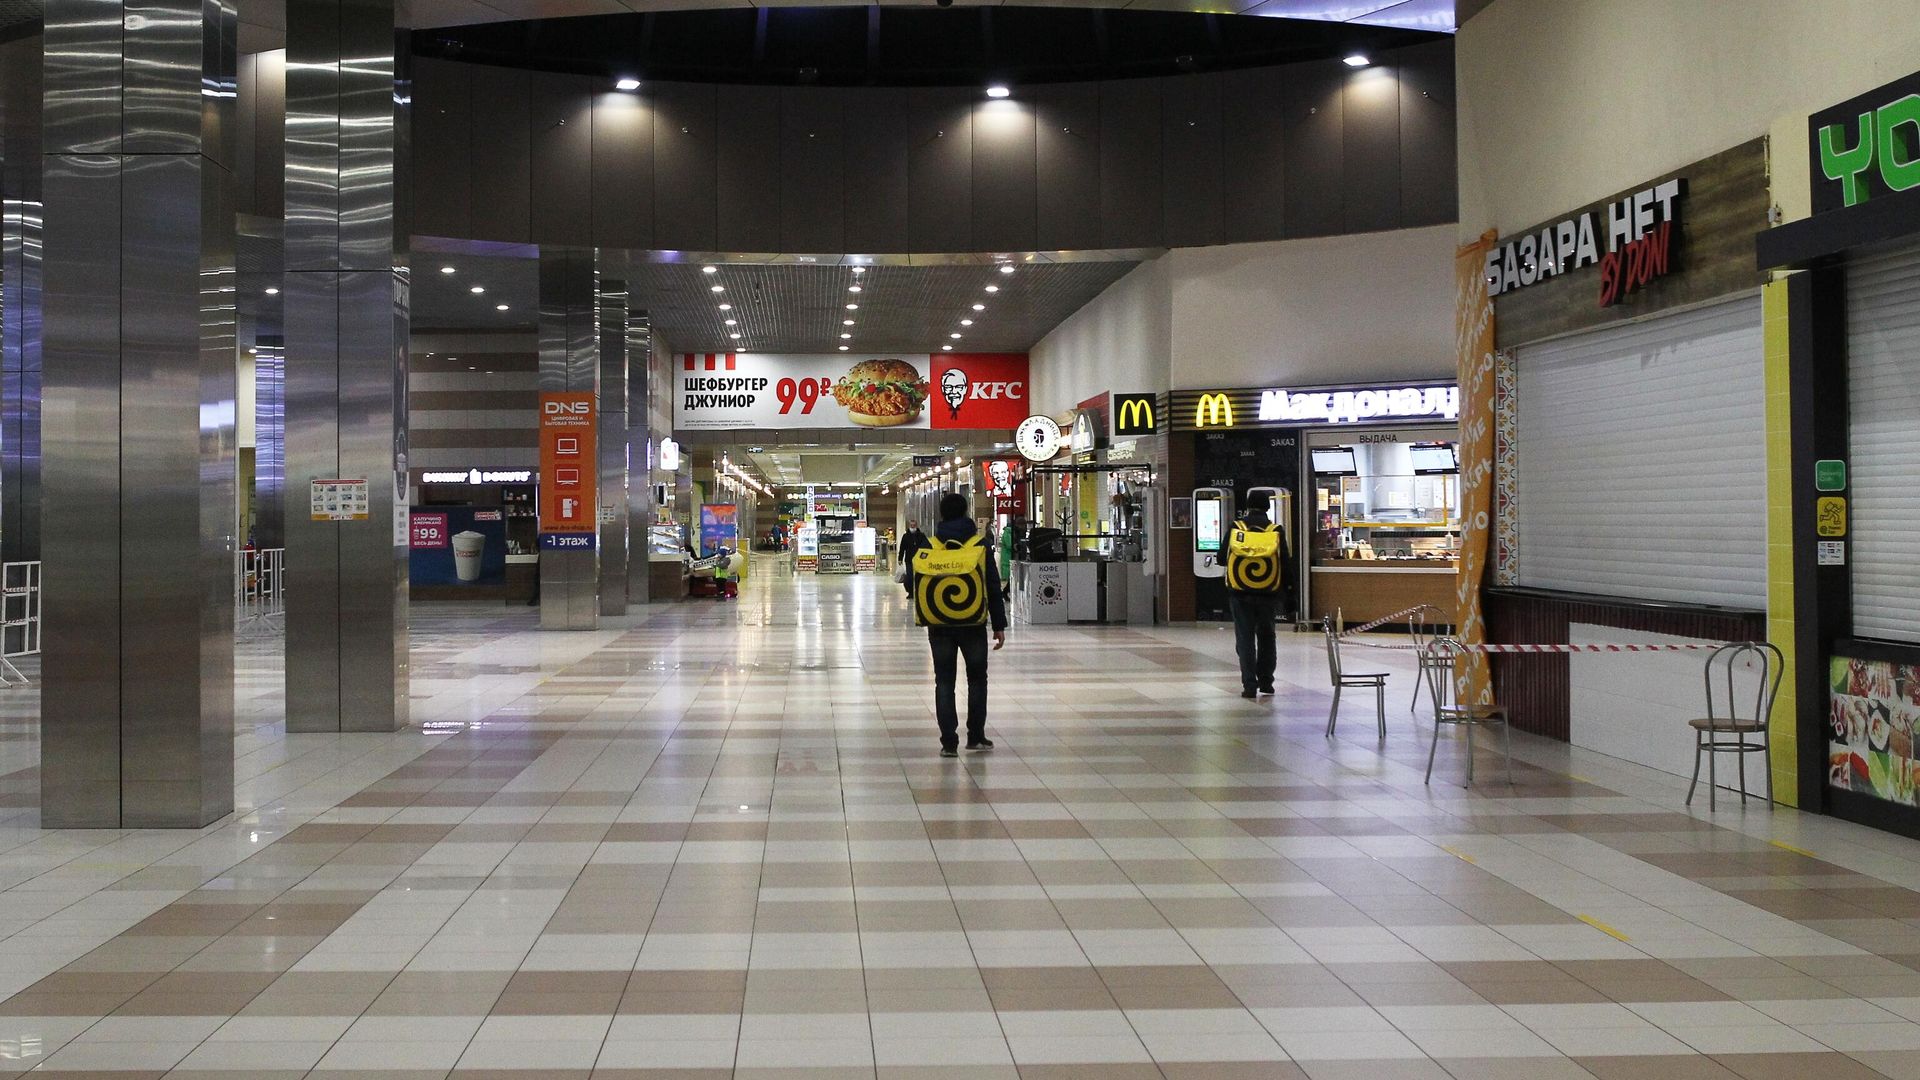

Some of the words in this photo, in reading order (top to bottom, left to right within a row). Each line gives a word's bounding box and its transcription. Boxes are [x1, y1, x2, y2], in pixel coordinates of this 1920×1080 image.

[1485, 212, 1598, 297] БАЗАРА
[1608, 178, 1679, 253] НЕТ
[1600, 242, 1625, 307] BY
[1625, 220, 1671, 294] DONI
[684, 377, 768, 393] ШЕФБУРГЕР
[968, 381, 1023, 400] KFC
[544, 401, 590, 414] DNS
[684, 394, 756, 410] ДЖУНИОР
[1271, 438, 1295, 447] ЗАКАЗ
[1359, 434, 1398, 444] ВЫДАЧА
[1211, 479, 1234, 487] ЗАКАЗ
[547, 535, 556, 546] -1
[559, 536, 589, 546] этаж
